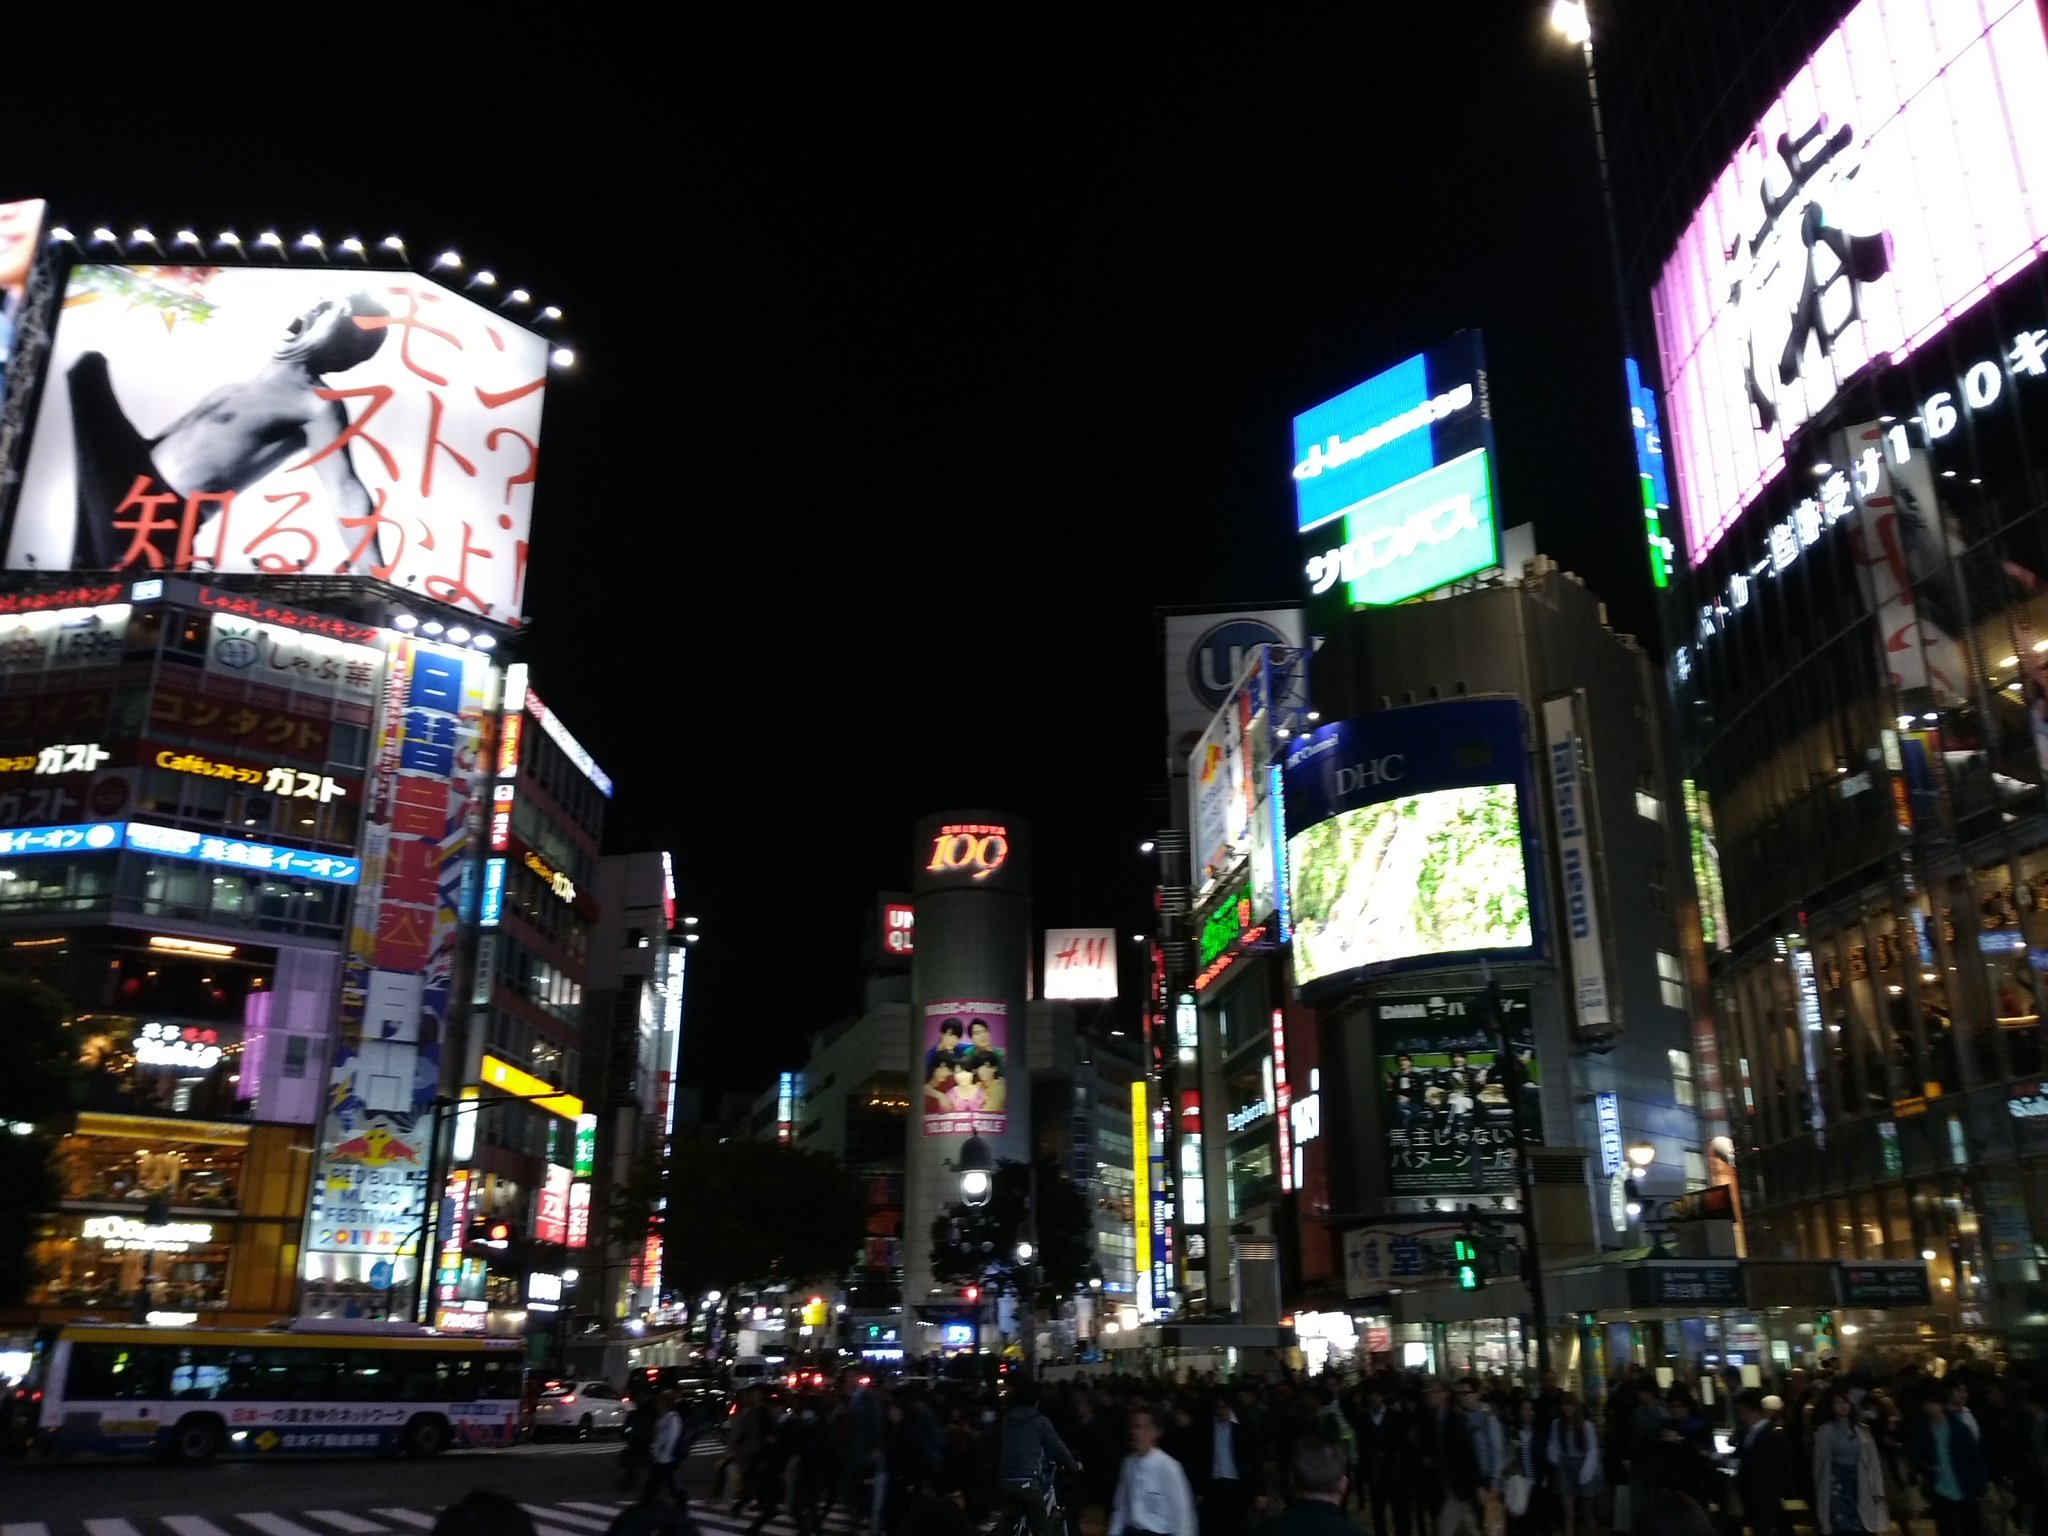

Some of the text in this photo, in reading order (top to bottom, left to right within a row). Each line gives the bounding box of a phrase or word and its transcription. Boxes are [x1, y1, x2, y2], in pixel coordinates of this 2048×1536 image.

[1306, 493, 1479, 594] サロンパス
[36, 743, 110, 775] ガスト
[1336, 753, 1405, 797] DHC
[263, 767, 347, 803] ガスト
[941, 825, 1007, 835] SHIBUYA
[927, 834, 1008, 880] 109
[1055, 937, 1109, 971] H&M
